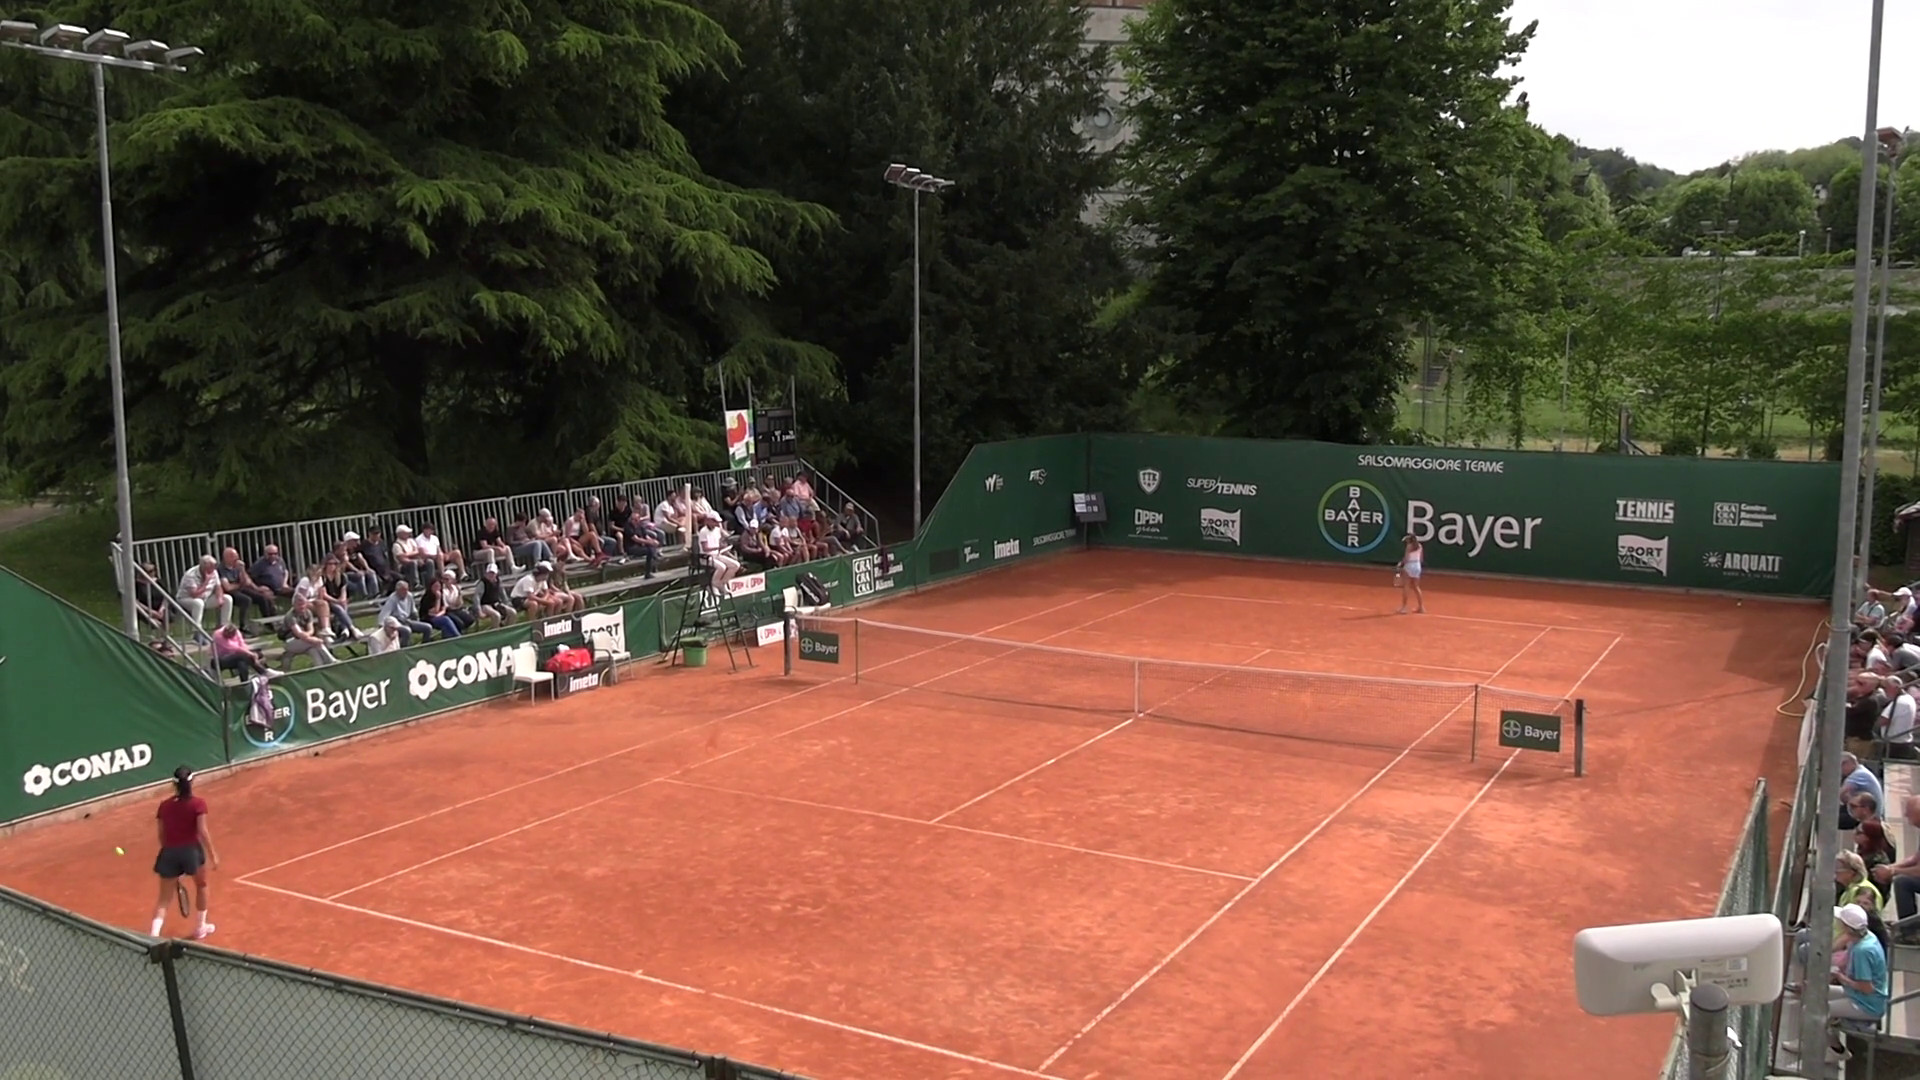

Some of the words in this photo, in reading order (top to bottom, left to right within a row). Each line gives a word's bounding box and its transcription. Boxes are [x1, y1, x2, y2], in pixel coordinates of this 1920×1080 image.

[1357, 454, 1461, 471] SALSOMAGGIORE
[1465, 459, 1504, 473] TERME
[1324, 508, 1384, 525] BAYER
[1616, 499, 1675, 520] TENNIS
[1201, 518, 1237, 530] SPORT
[1406, 499, 1543, 558] Bayer
[1618, 545, 1664, 558] SPORT
[1723, 552, 1782, 573] ARQUATI
[814, 642, 838, 656] Bayer
[437, 645, 514, 690] CONA
[306, 678, 392, 725] Bayer
[1524, 725, 1559, 741] Bayer
[52, 743, 153, 787] CONAD
